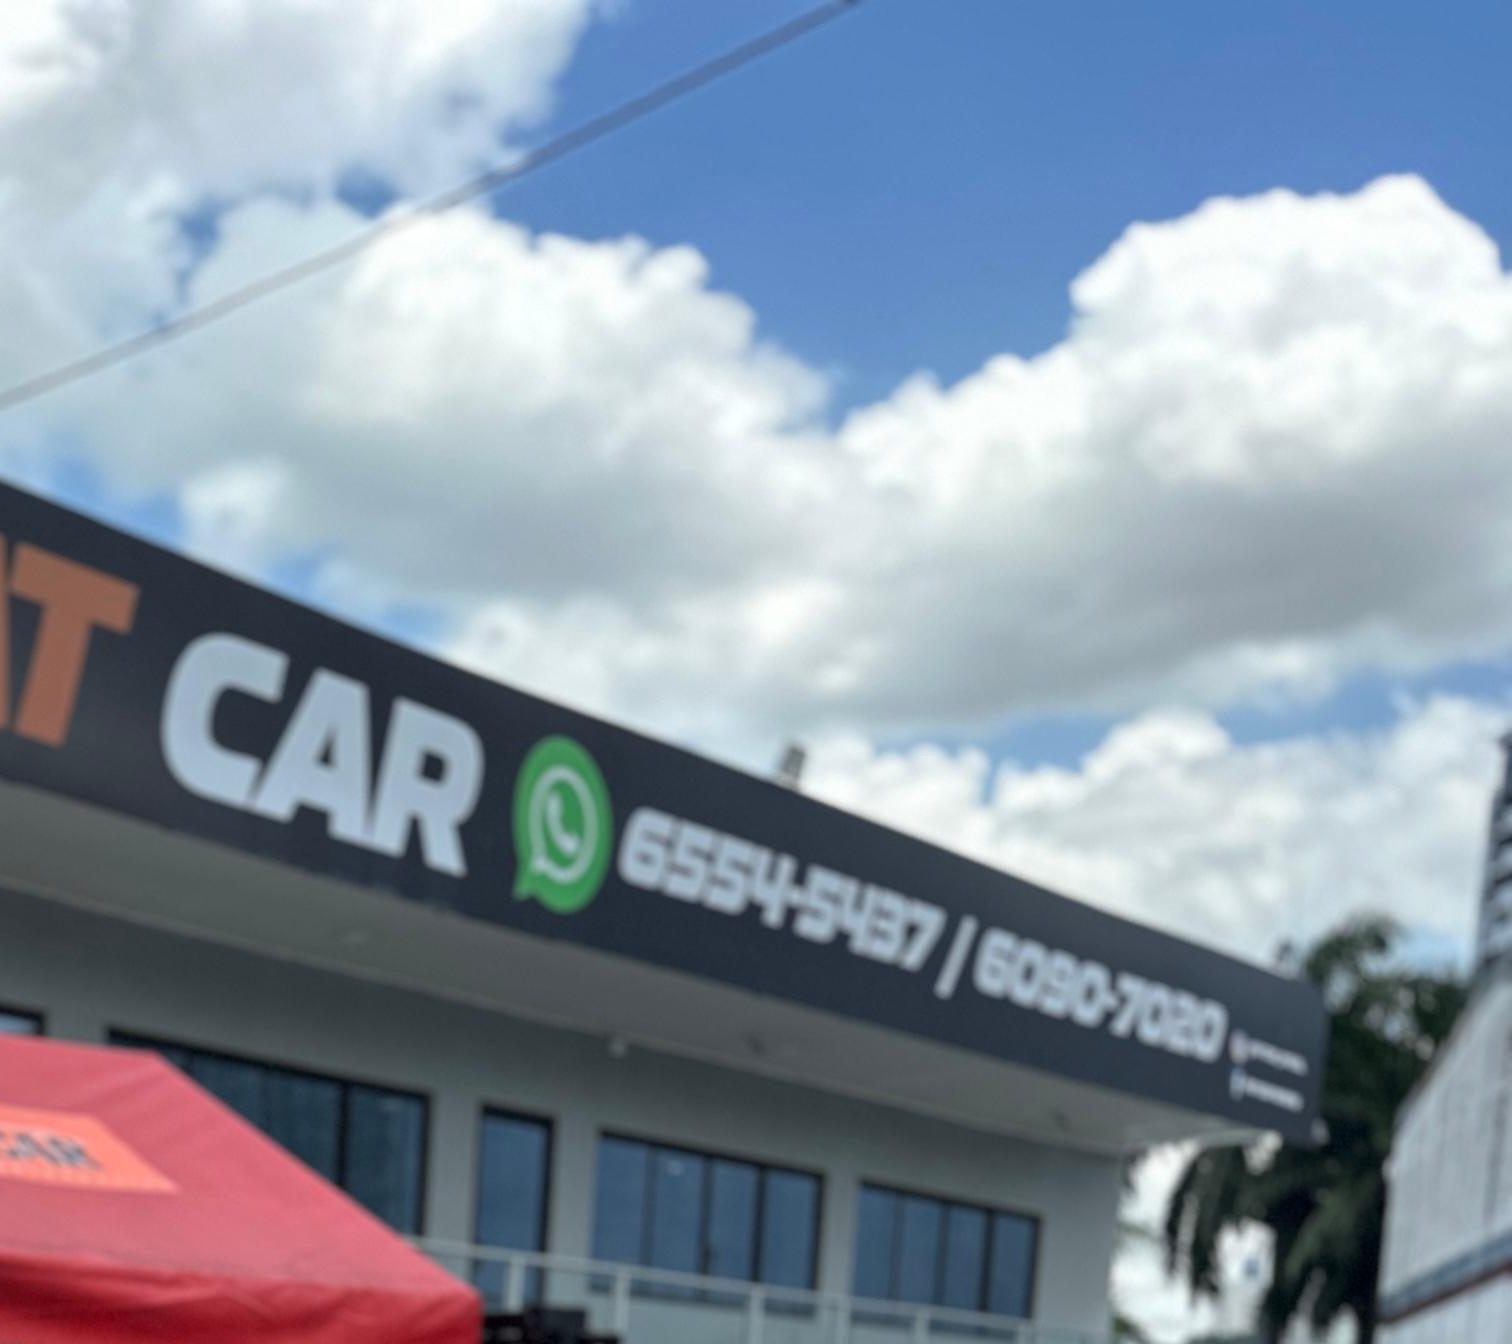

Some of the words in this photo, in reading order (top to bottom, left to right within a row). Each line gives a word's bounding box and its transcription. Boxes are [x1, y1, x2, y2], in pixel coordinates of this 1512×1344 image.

[159, 630, 485, 878] CAR
[617, 804, 948, 974] 6554-5437
[972, 926, 1229, 1065] 6090-7020
